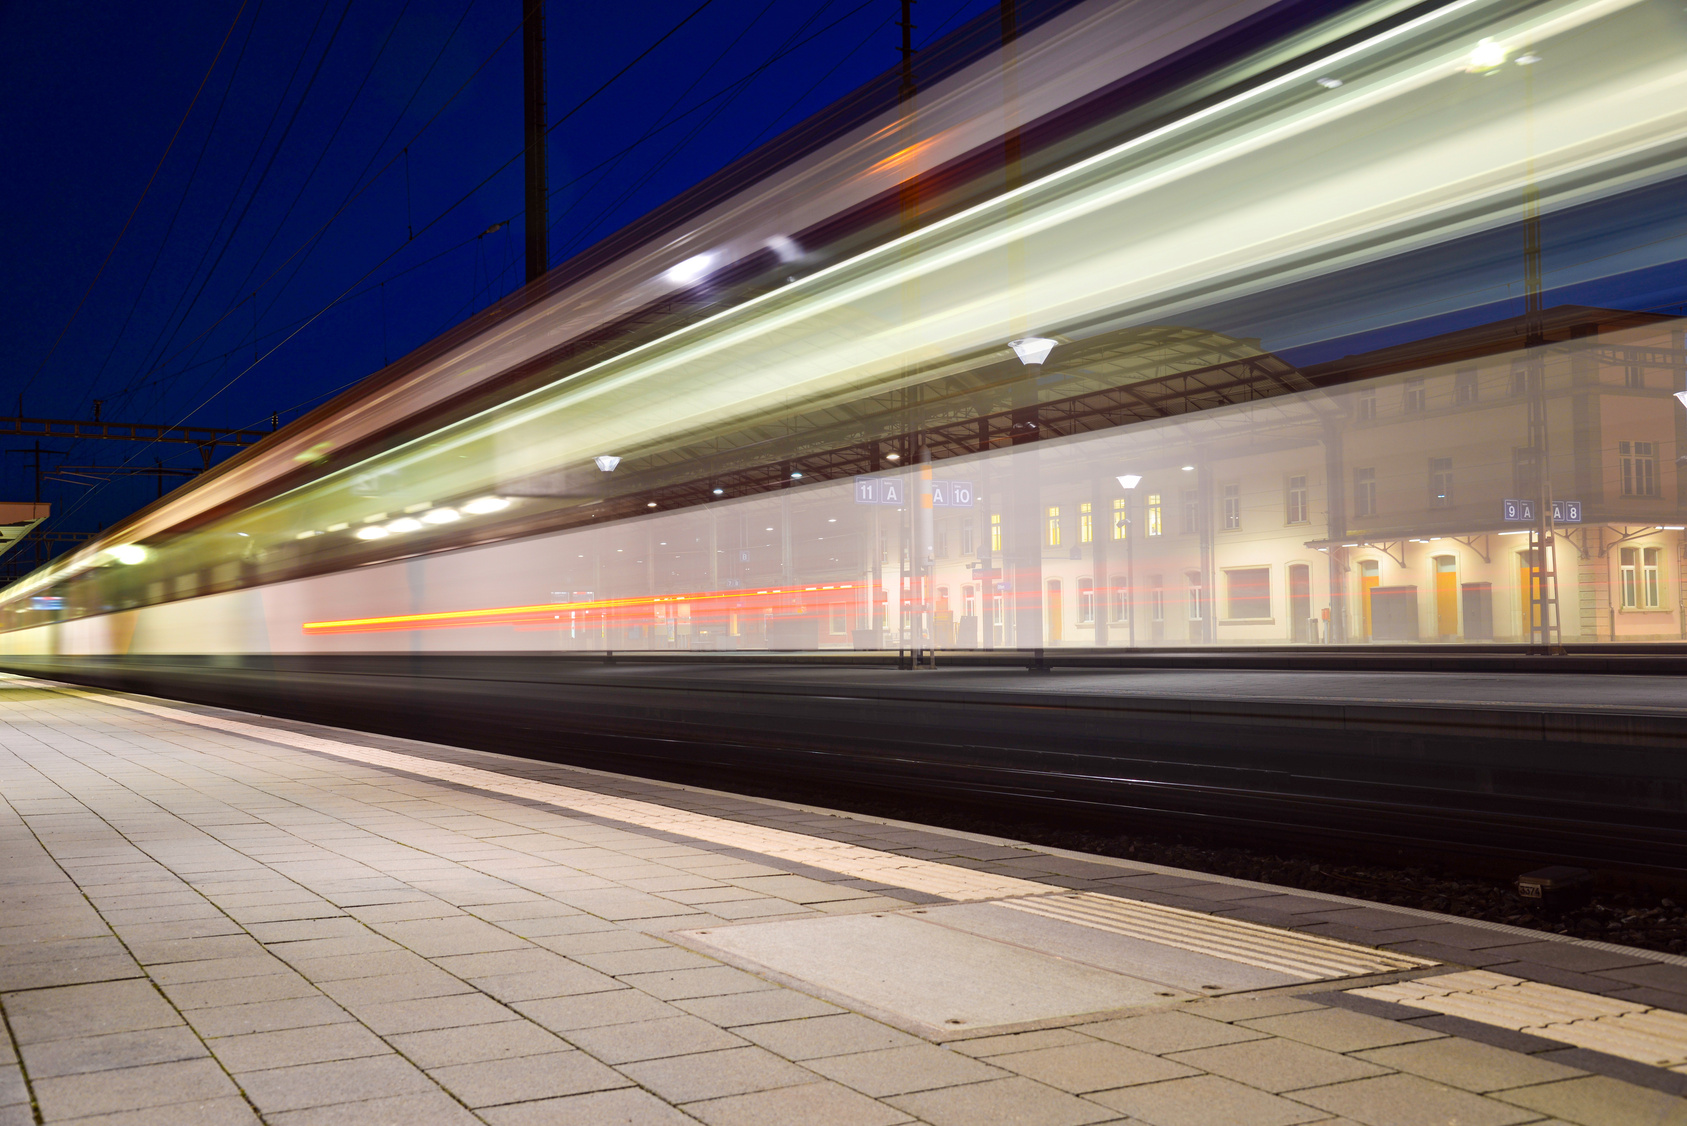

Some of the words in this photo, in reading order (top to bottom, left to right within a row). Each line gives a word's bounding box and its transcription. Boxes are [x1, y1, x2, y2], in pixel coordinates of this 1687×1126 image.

[860, 485, 872, 500] 11
[886, 486, 897, 500] A
[933, 488, 944, 503] A
[954, 489, 970, 503] 10
[1508, 505, 1516, 517] 9
[1524, 507, 1531, 518] A
[1553, 507, 1561, 518] A
[1570, 507, 1577, 519] 8
